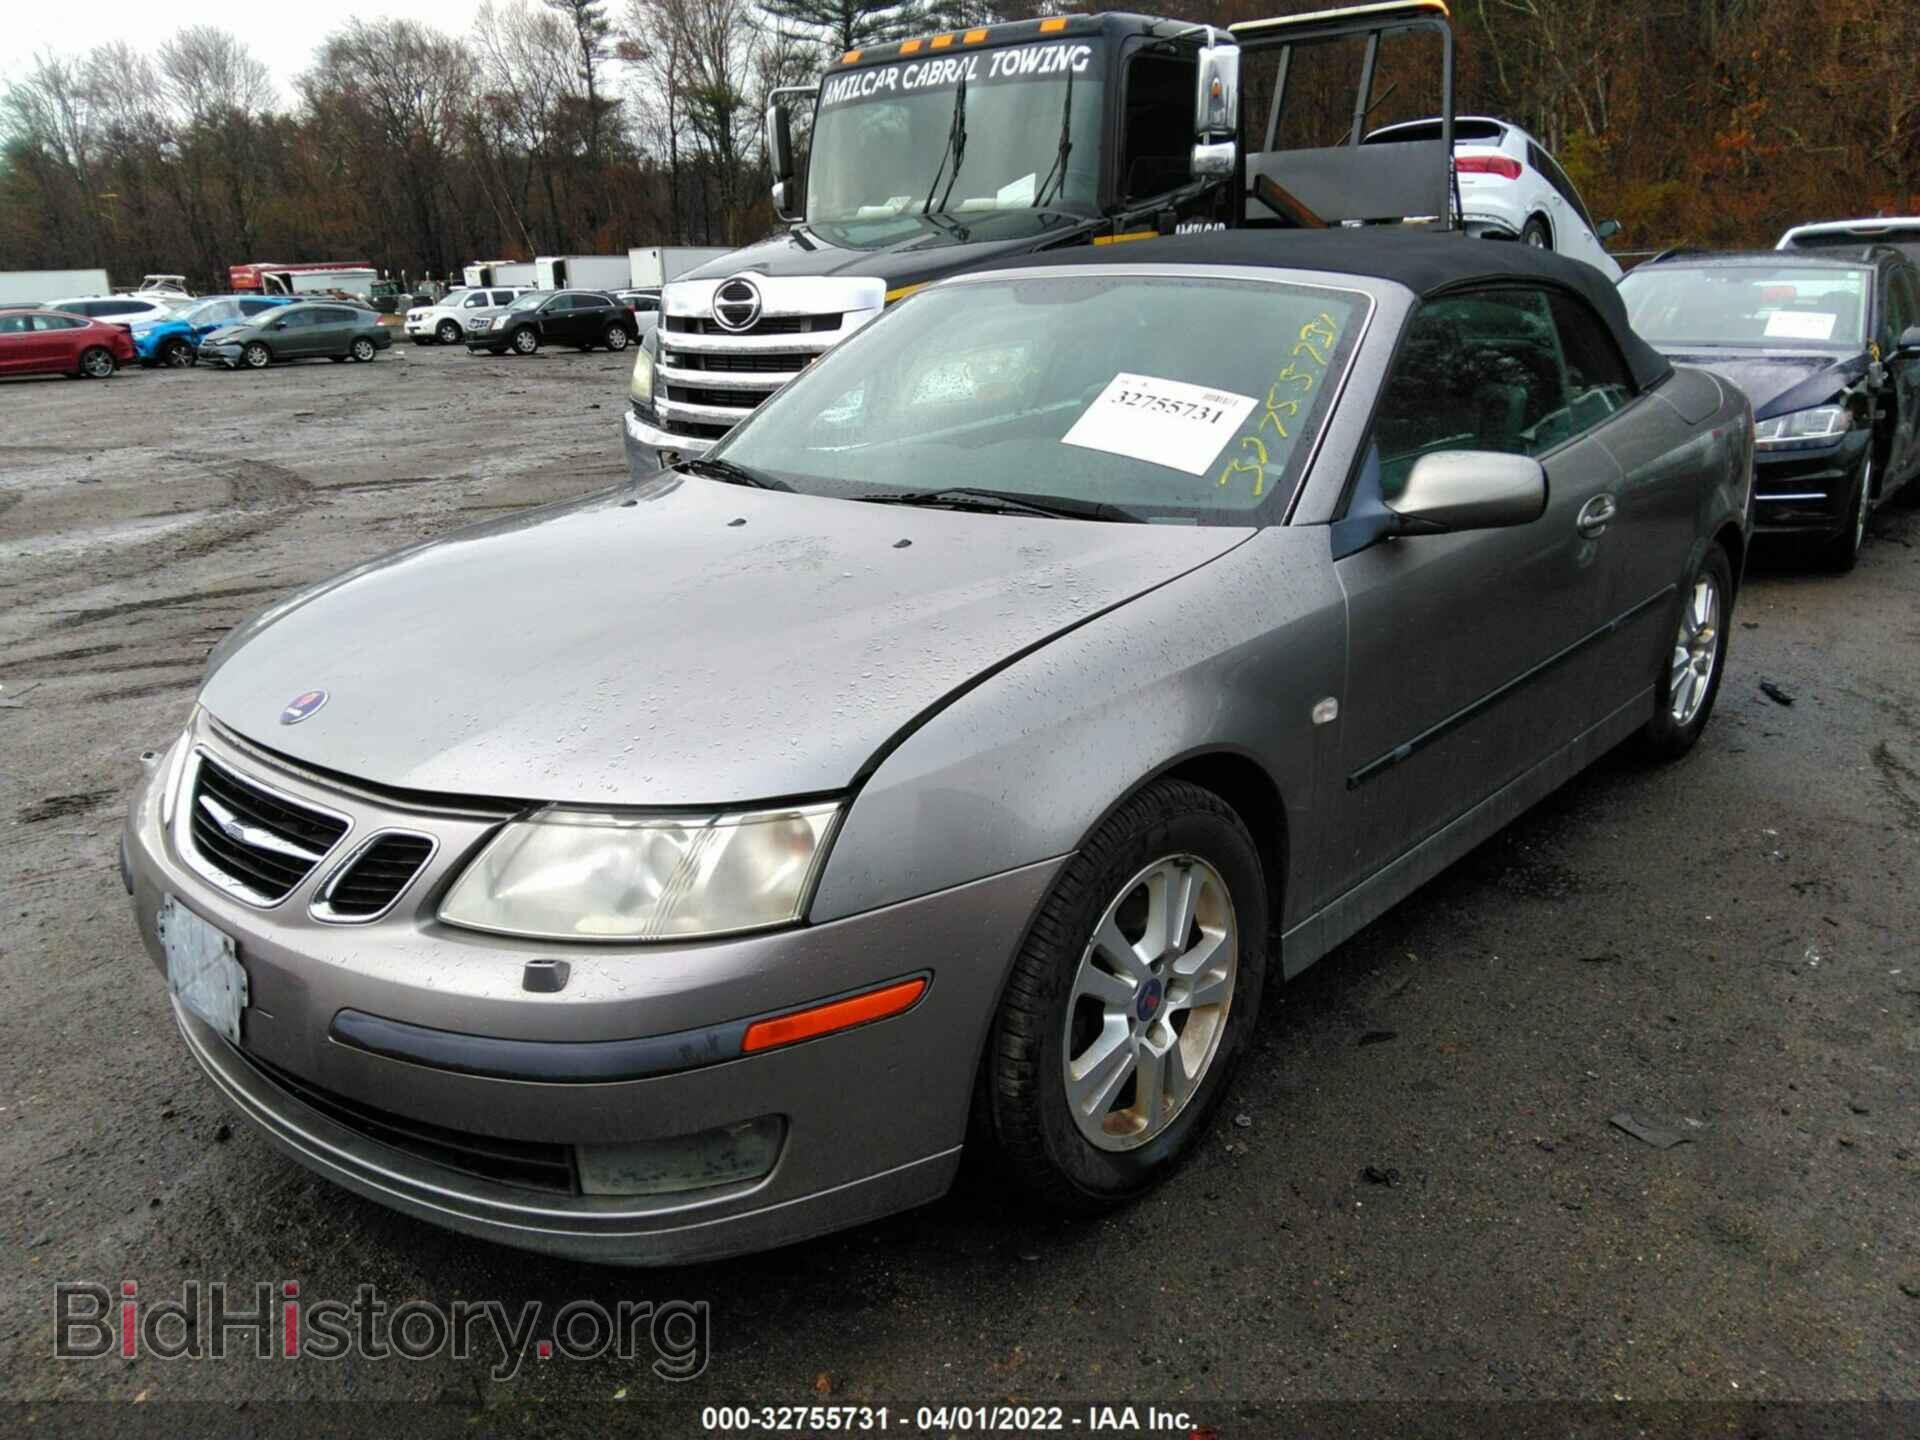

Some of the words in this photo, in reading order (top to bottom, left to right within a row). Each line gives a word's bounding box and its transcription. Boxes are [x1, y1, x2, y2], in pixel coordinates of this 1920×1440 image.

[822, 67, 899, 107] AMILCAR
[902, 55, 979, 89] CABRAL
[989, 45, 1092, 77] TOWING
[1111, 390, 1224, 424] 32755731
